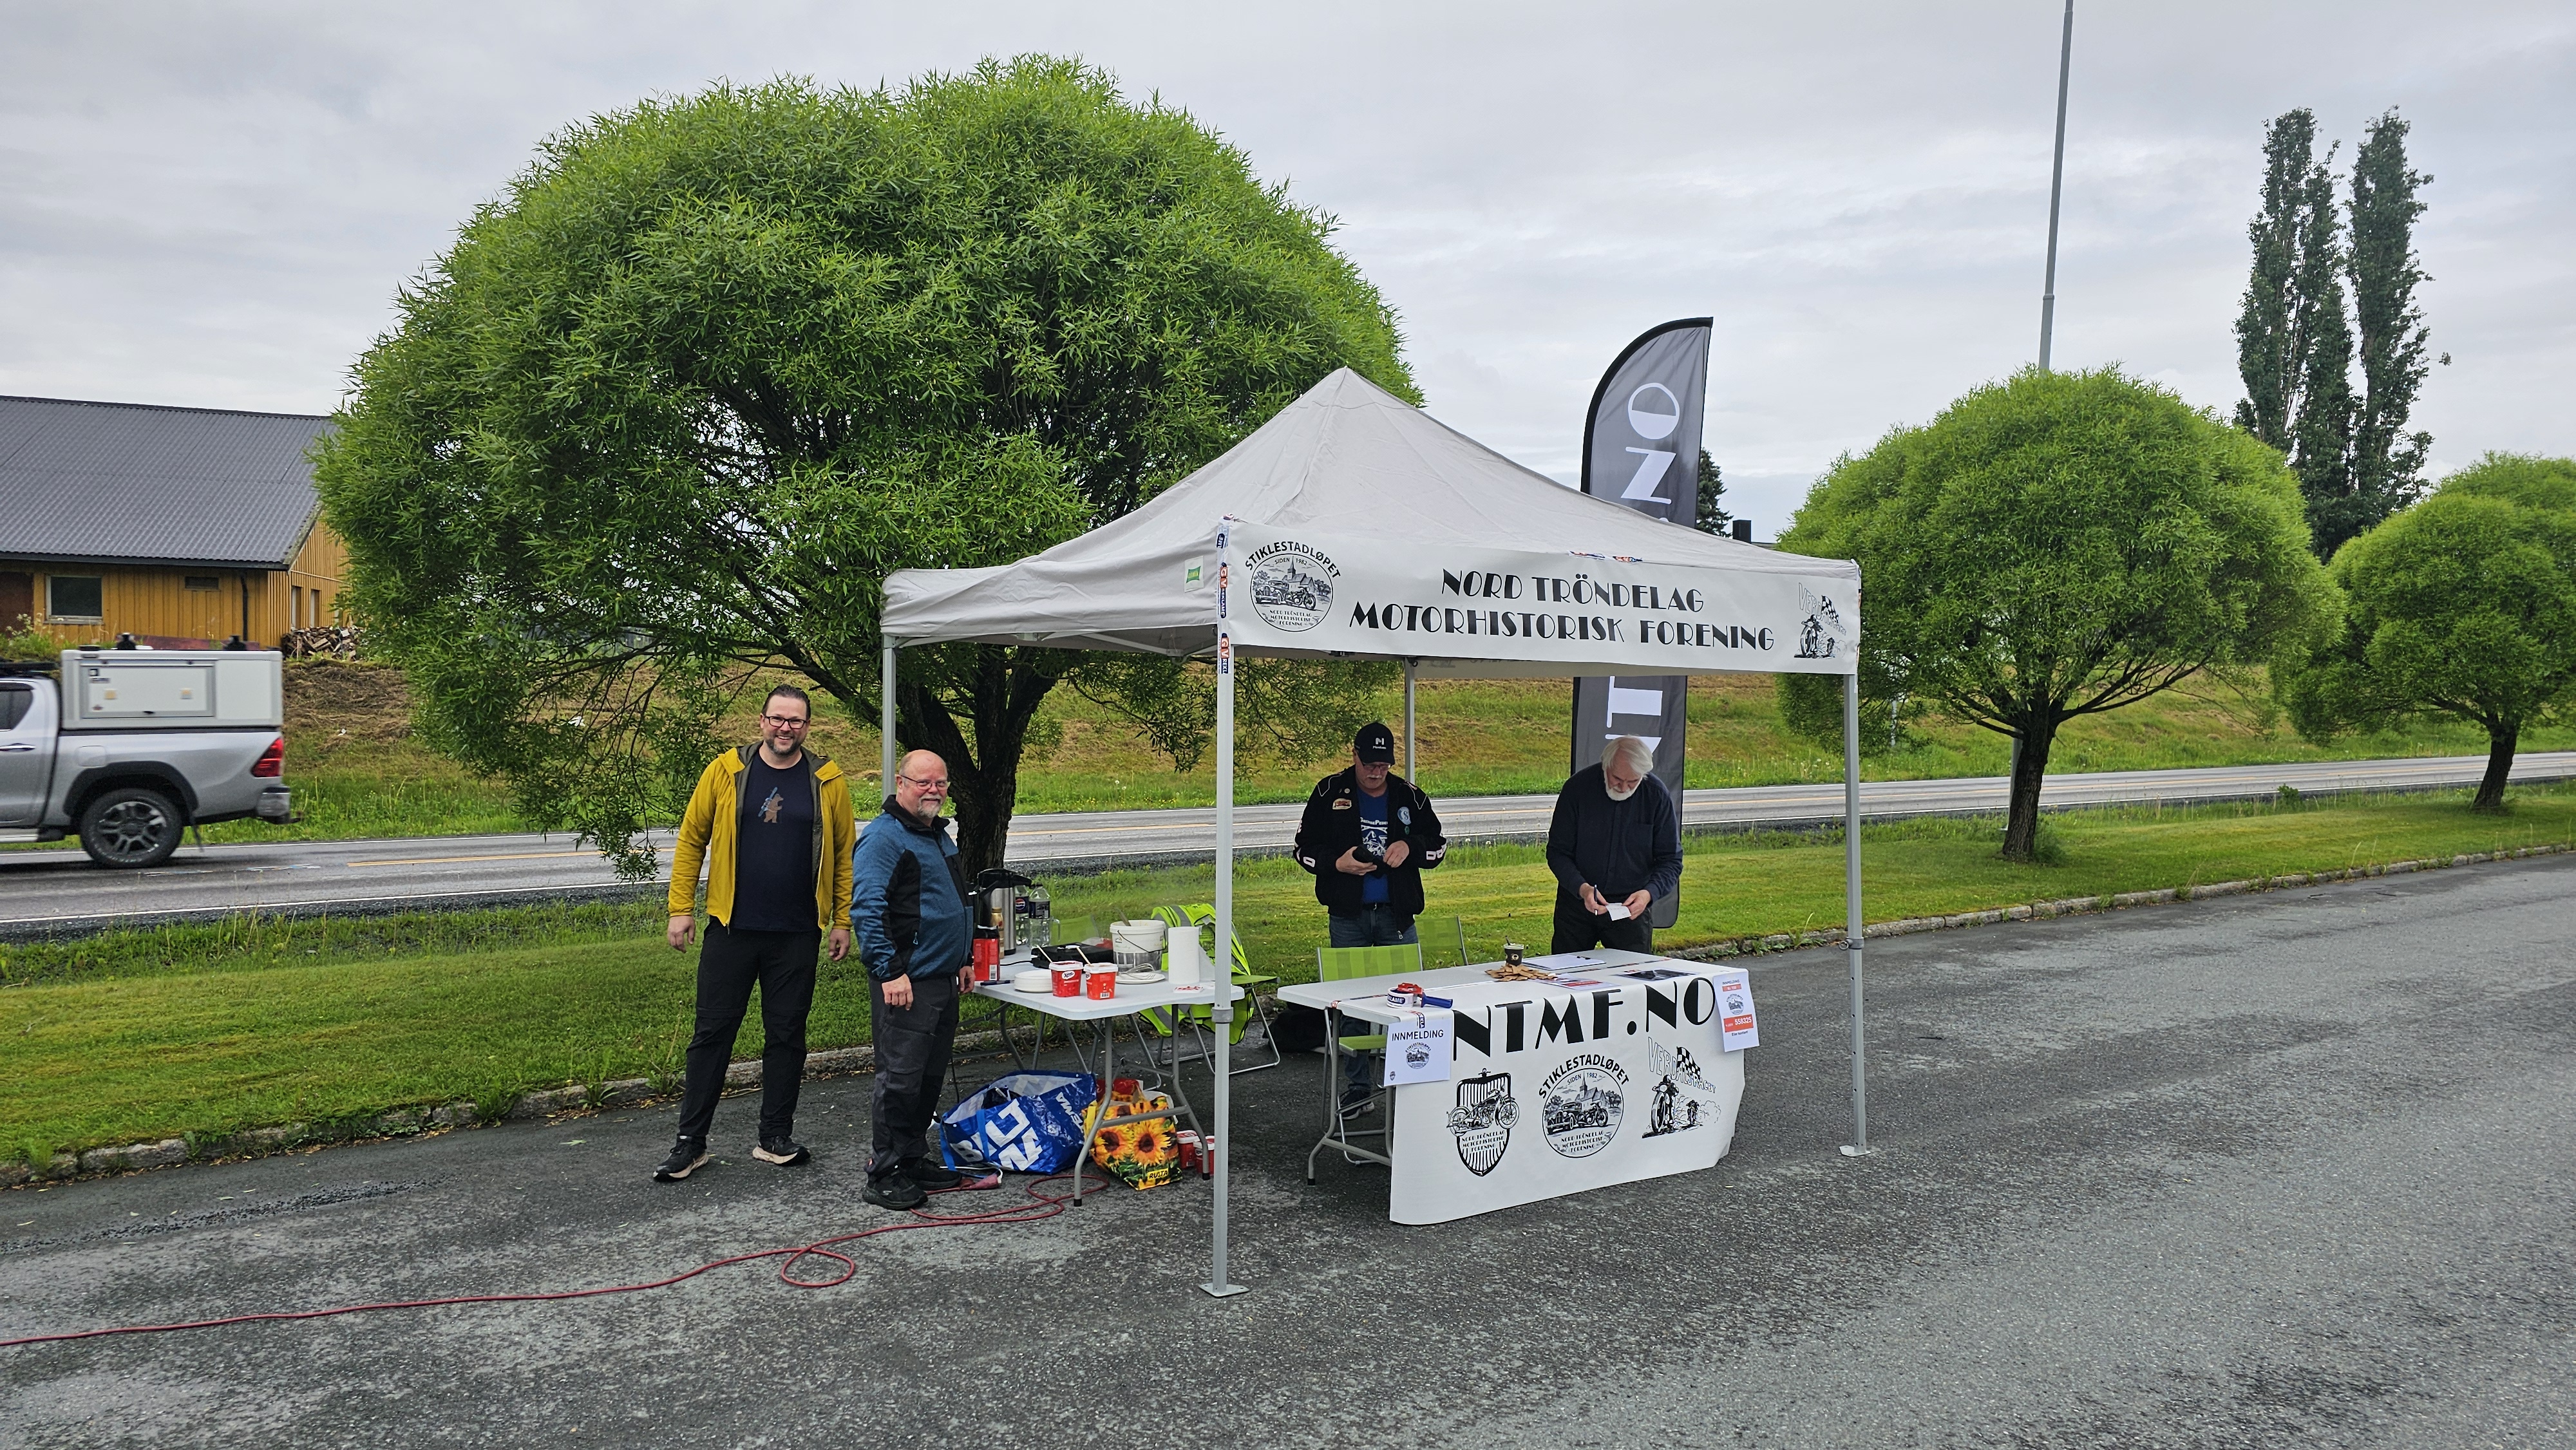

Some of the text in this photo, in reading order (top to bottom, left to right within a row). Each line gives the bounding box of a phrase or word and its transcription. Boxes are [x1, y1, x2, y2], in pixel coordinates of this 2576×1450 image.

[1245, 541, 1341, 578] STIKLESTADLØPET
[1441, 568, 1704, 612] NORD TRÖNDELAG
[1349, 600, 1774, 651] MOTORHISTORISK FORENING
[1392, 1030, 1444, 1041] INNMELDING
[1453, 977, 1716, 1062] NTMF.NO
[1539, 1054, 1629, 1098] STIKLESTADLØPET
[1567, 1074, 1582, 1085] SIDEN
